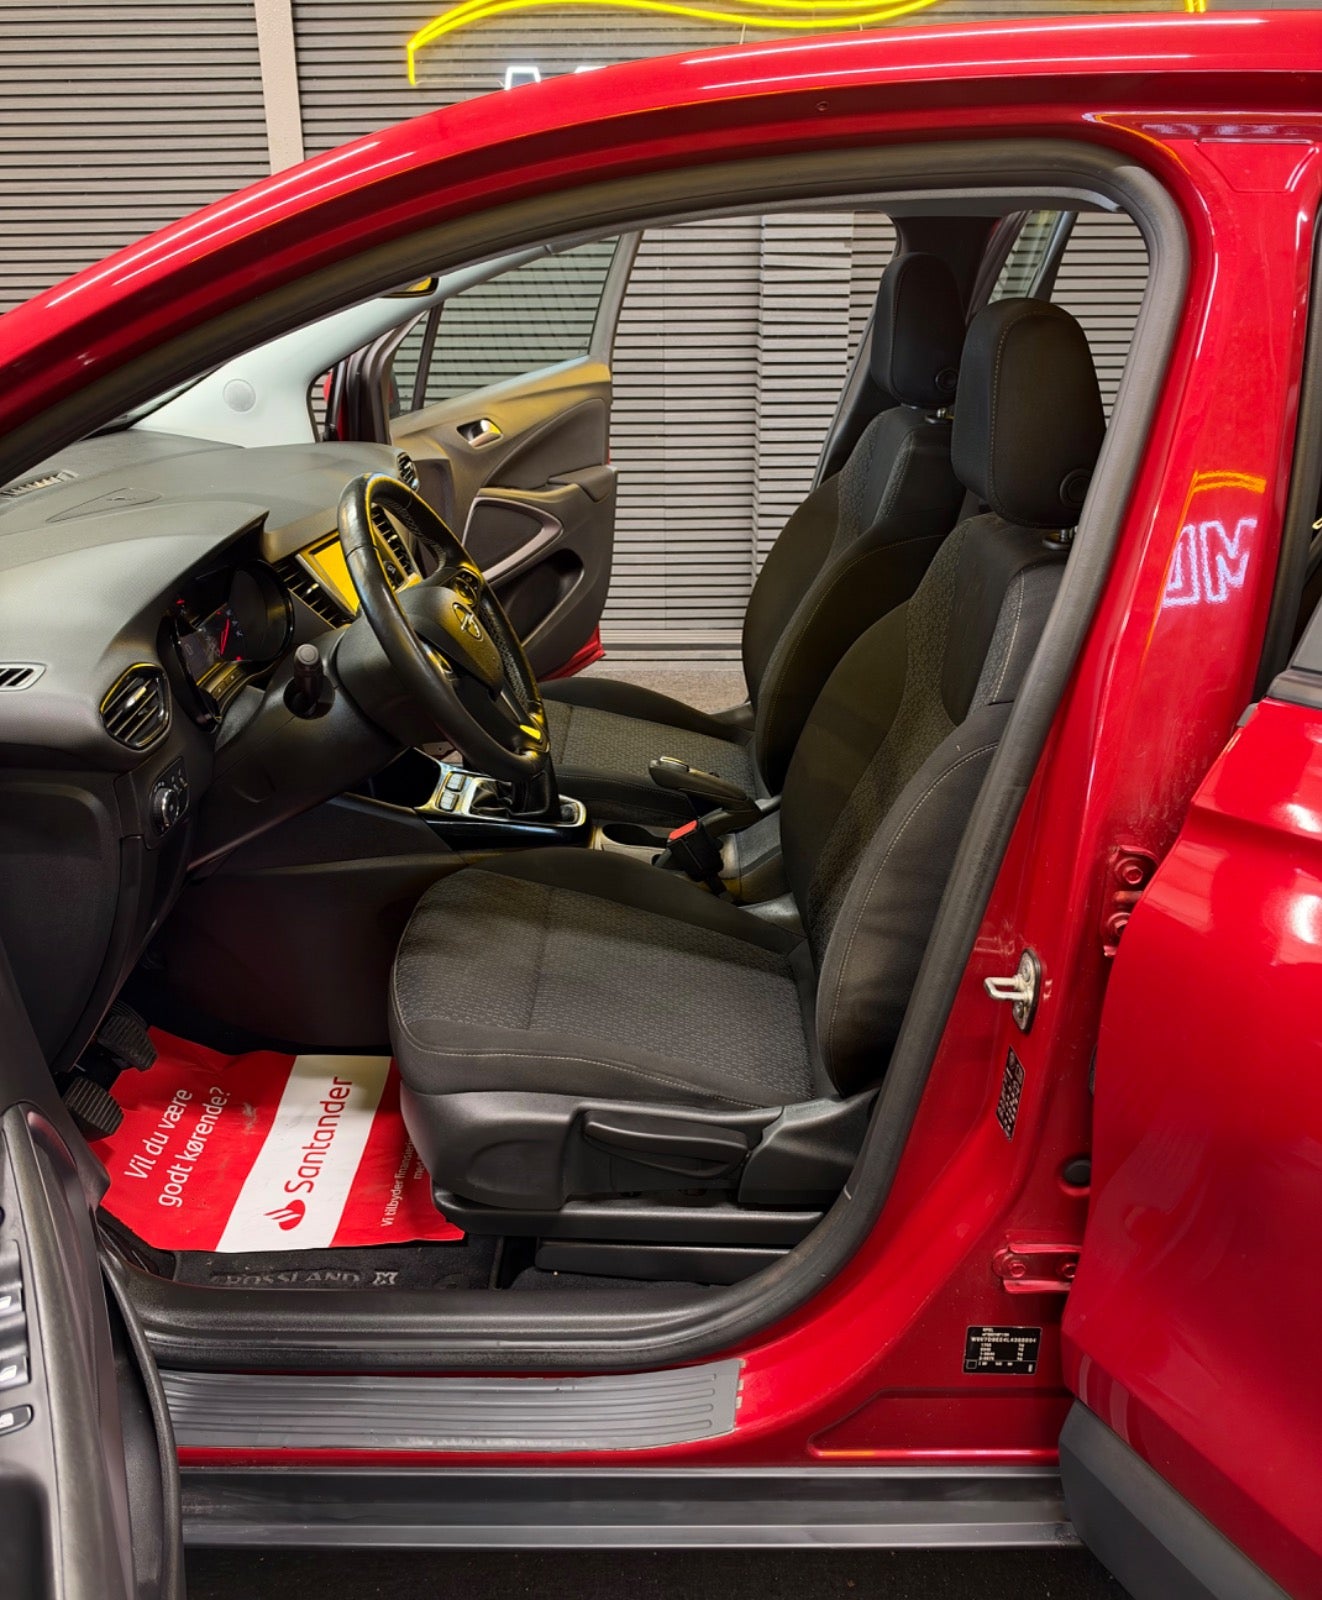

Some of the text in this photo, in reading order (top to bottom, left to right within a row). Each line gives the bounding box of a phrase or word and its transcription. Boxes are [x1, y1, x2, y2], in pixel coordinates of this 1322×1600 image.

[124, 1089, 193, 1179] Vil du være
[158, 1086, 231, 1208] godt kørende?
[284, 1076, 353, 1193] Santander
[381, 1217, 395, 1227] Vi
[384, 1180, 404, 1216] tilbyder
